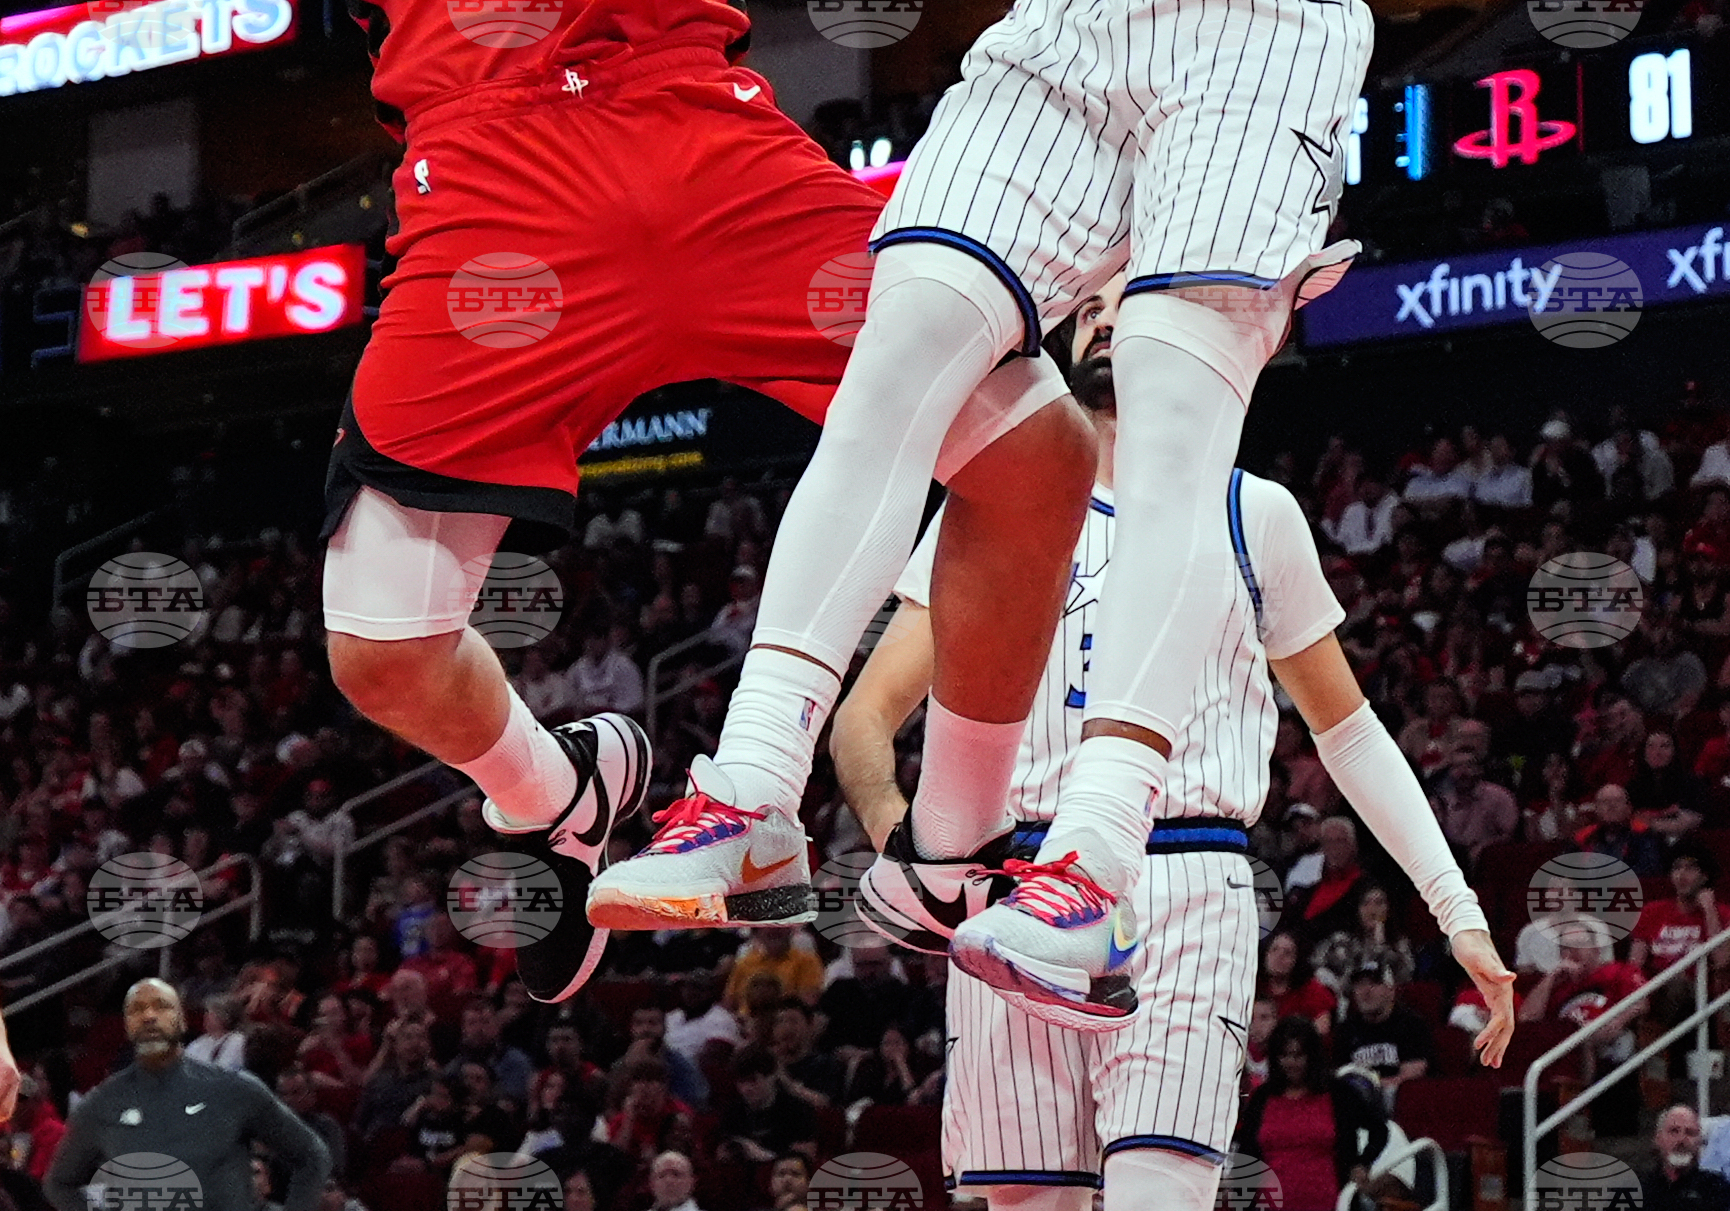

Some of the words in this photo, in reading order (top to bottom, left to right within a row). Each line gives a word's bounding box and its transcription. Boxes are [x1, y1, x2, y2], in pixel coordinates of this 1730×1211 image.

[1628, 48, 1692, 144] 81
[106, 261, 348, 341] LET'S
[1395, 257, 1563, 328] xfinity
